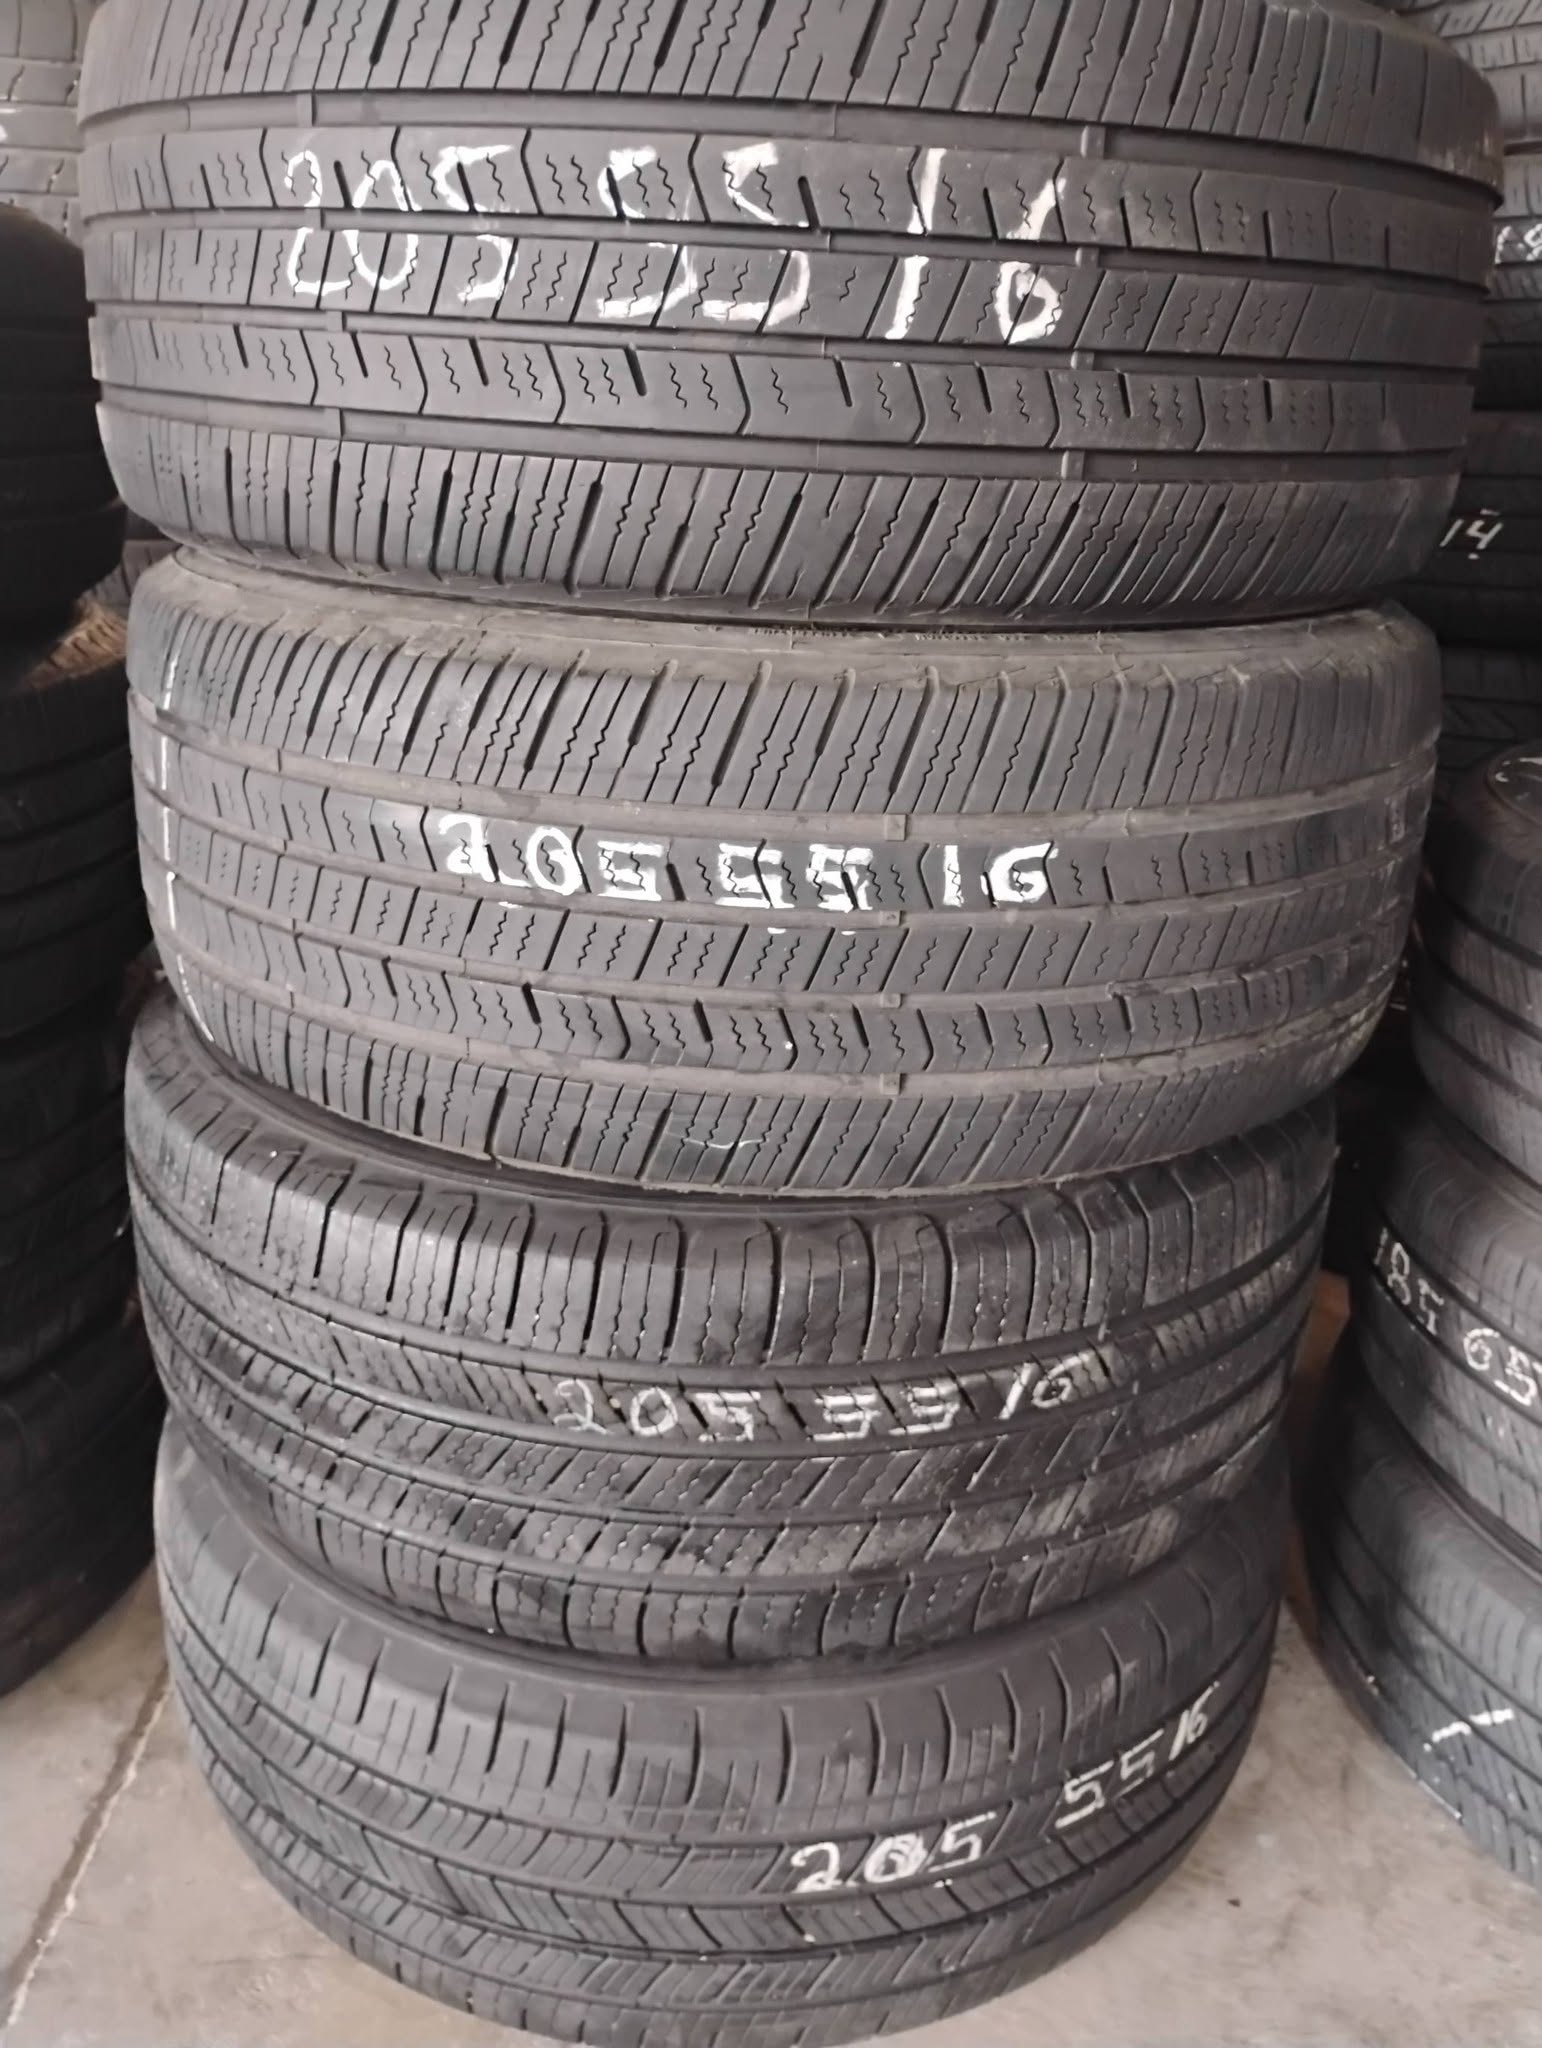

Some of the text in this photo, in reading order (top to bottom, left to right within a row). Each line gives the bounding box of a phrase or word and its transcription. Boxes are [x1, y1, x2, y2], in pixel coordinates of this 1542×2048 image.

[284, 139, 1067, 345] 205 55 16
[439, 812, 1058, 913] 205 55 16
[552, 1376, 761, 1442] 205
[994, 1350, 1095, 1420] 16
[790, 1811, 997, 1894] 205
